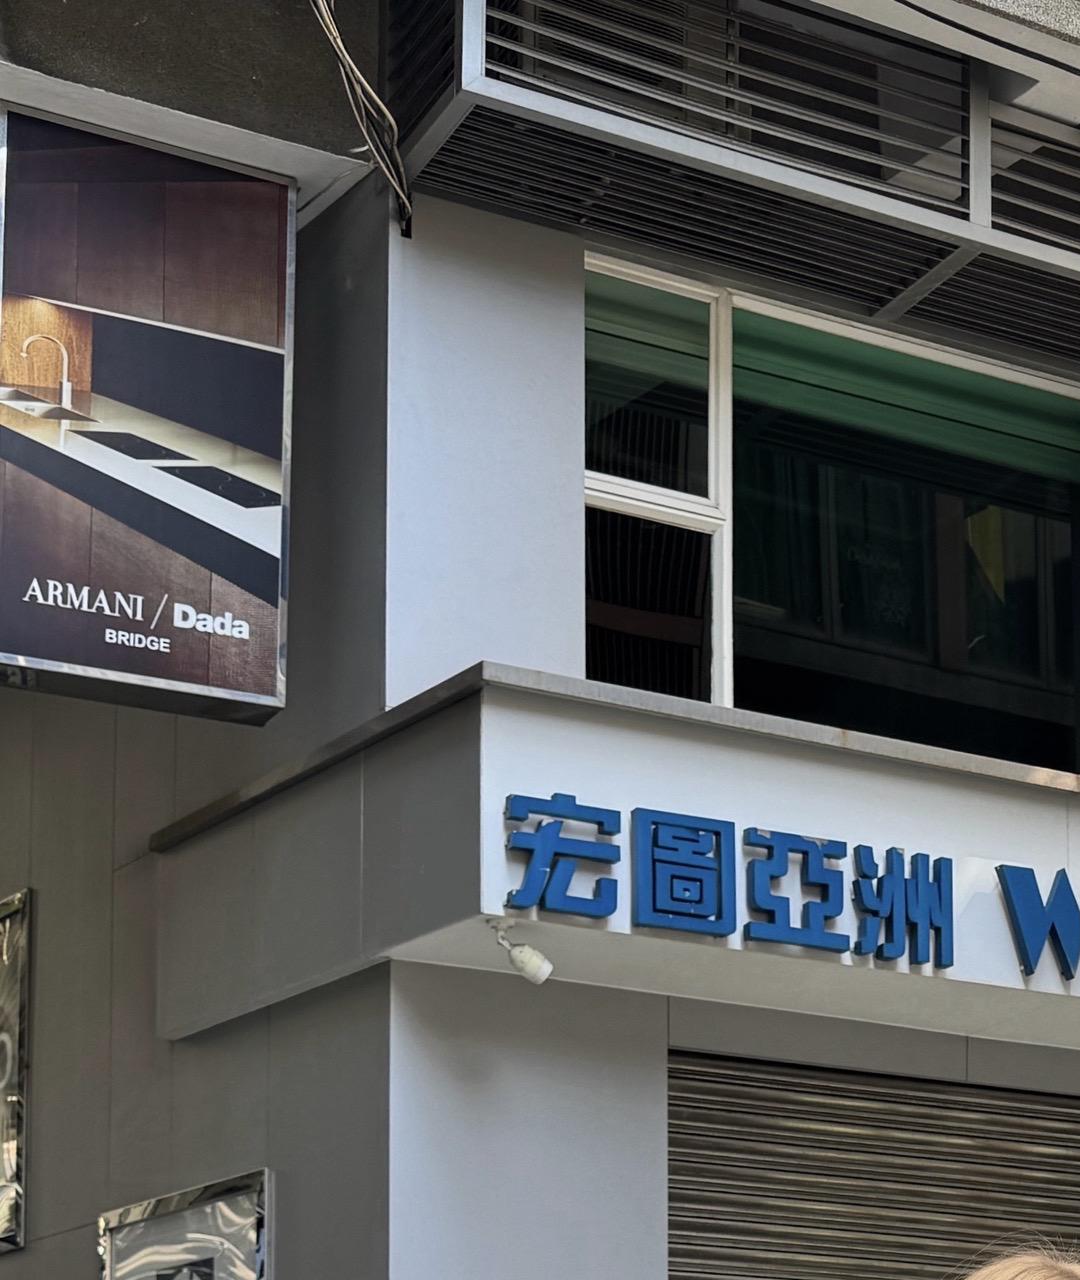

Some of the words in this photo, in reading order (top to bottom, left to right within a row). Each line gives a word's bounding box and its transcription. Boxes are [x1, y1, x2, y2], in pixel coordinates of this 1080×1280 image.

[22, 577, 144, 621] ARMANI
[173, 602, 250, 640] Dada
[104, 628, 171, 653] BRIDGE
[504, 792, 954, 969] 宏圖亞洲
